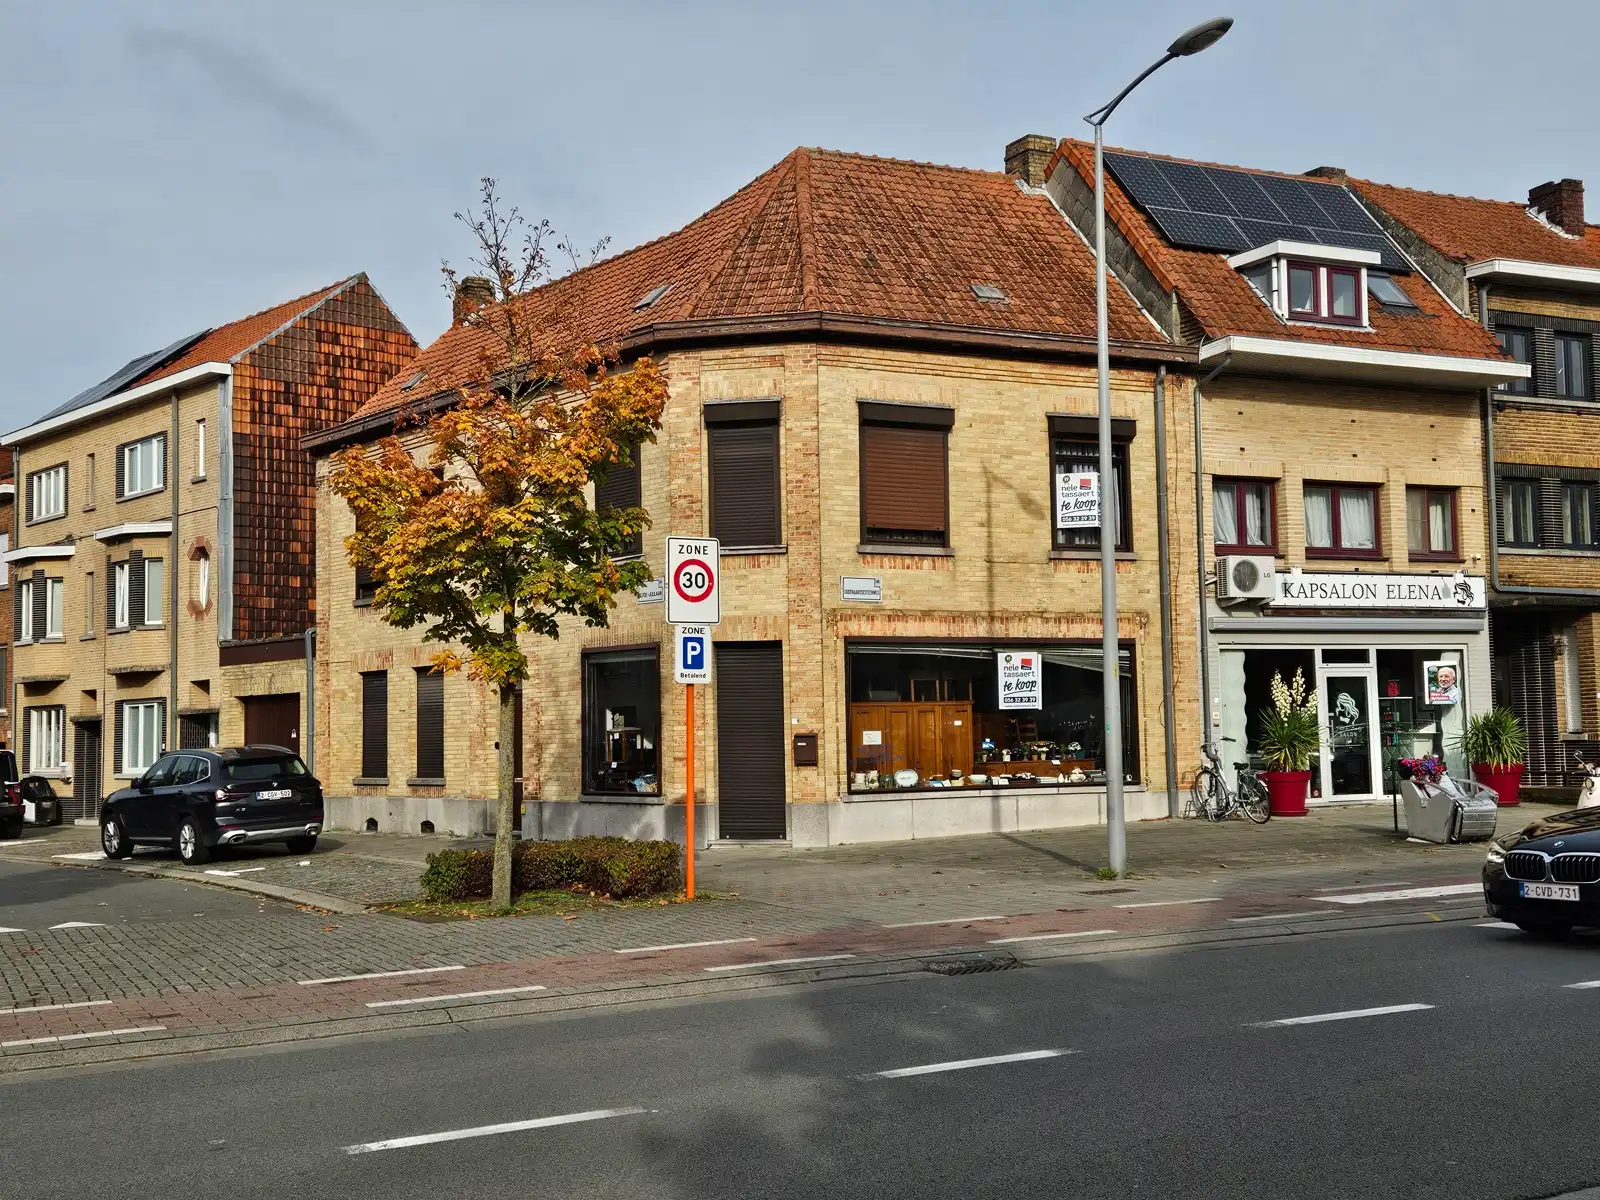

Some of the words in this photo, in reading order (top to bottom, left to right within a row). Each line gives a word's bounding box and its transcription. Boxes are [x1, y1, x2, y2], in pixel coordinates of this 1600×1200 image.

[1061, 500, 1072, 511] te
[1073, 498, 1096, 512] koop
[678, 544, 708, 555] ZONE
[682, 572, 705, 589] 30
[1283, 582, 1377, 599] KAPSALON
[1386, 584, 1442, 600] ELENA
[687, 642, 701, 664] P
[1004, 681, 1013, 692] te
[1015, 678, 1036, 692] koop
